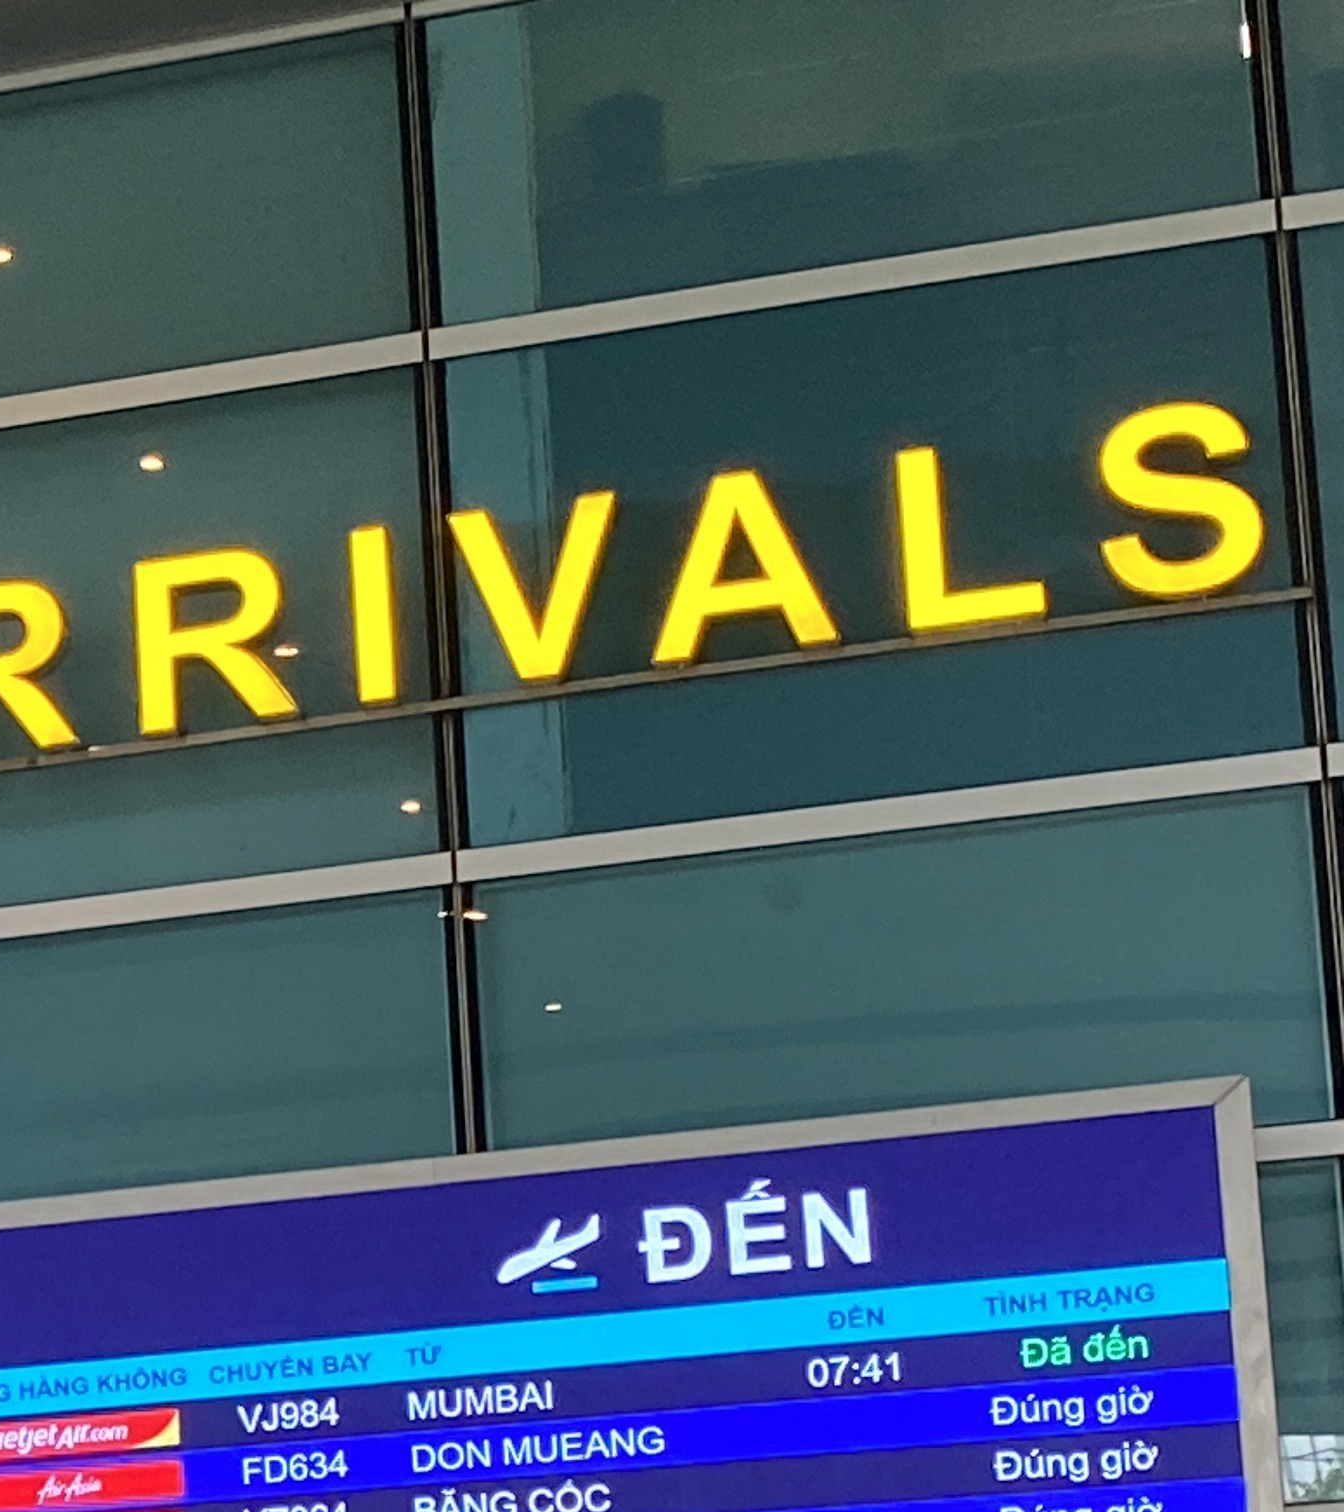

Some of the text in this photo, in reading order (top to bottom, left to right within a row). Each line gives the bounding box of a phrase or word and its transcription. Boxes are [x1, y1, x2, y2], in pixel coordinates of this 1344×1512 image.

[637, 1178, 872, 1284] ĐẾN
[236, 1396, 340, 1433] VJ984
[406, 1379, 554, 1421] MUMBAI
[807, 1351, 901, 1388] 07:41
[1019, 1335, 1073, 1369] Đã
[1082, 1323, 1150, 1363] đến
[322, 1352, 372, 1375] BAY
[242, 1449, 349, 1485] FD634
[410, 1438, 492, 1473] DON
[502, 1425, 665, 1466] MUEANG
[989, 1393, 1085, 1427] Đúng
[1096, 1385, 1154, 1424] giờ
[992, 1448, 1090, 1483] Đúng
[1100, 1439, 1159, 1480] giờ
